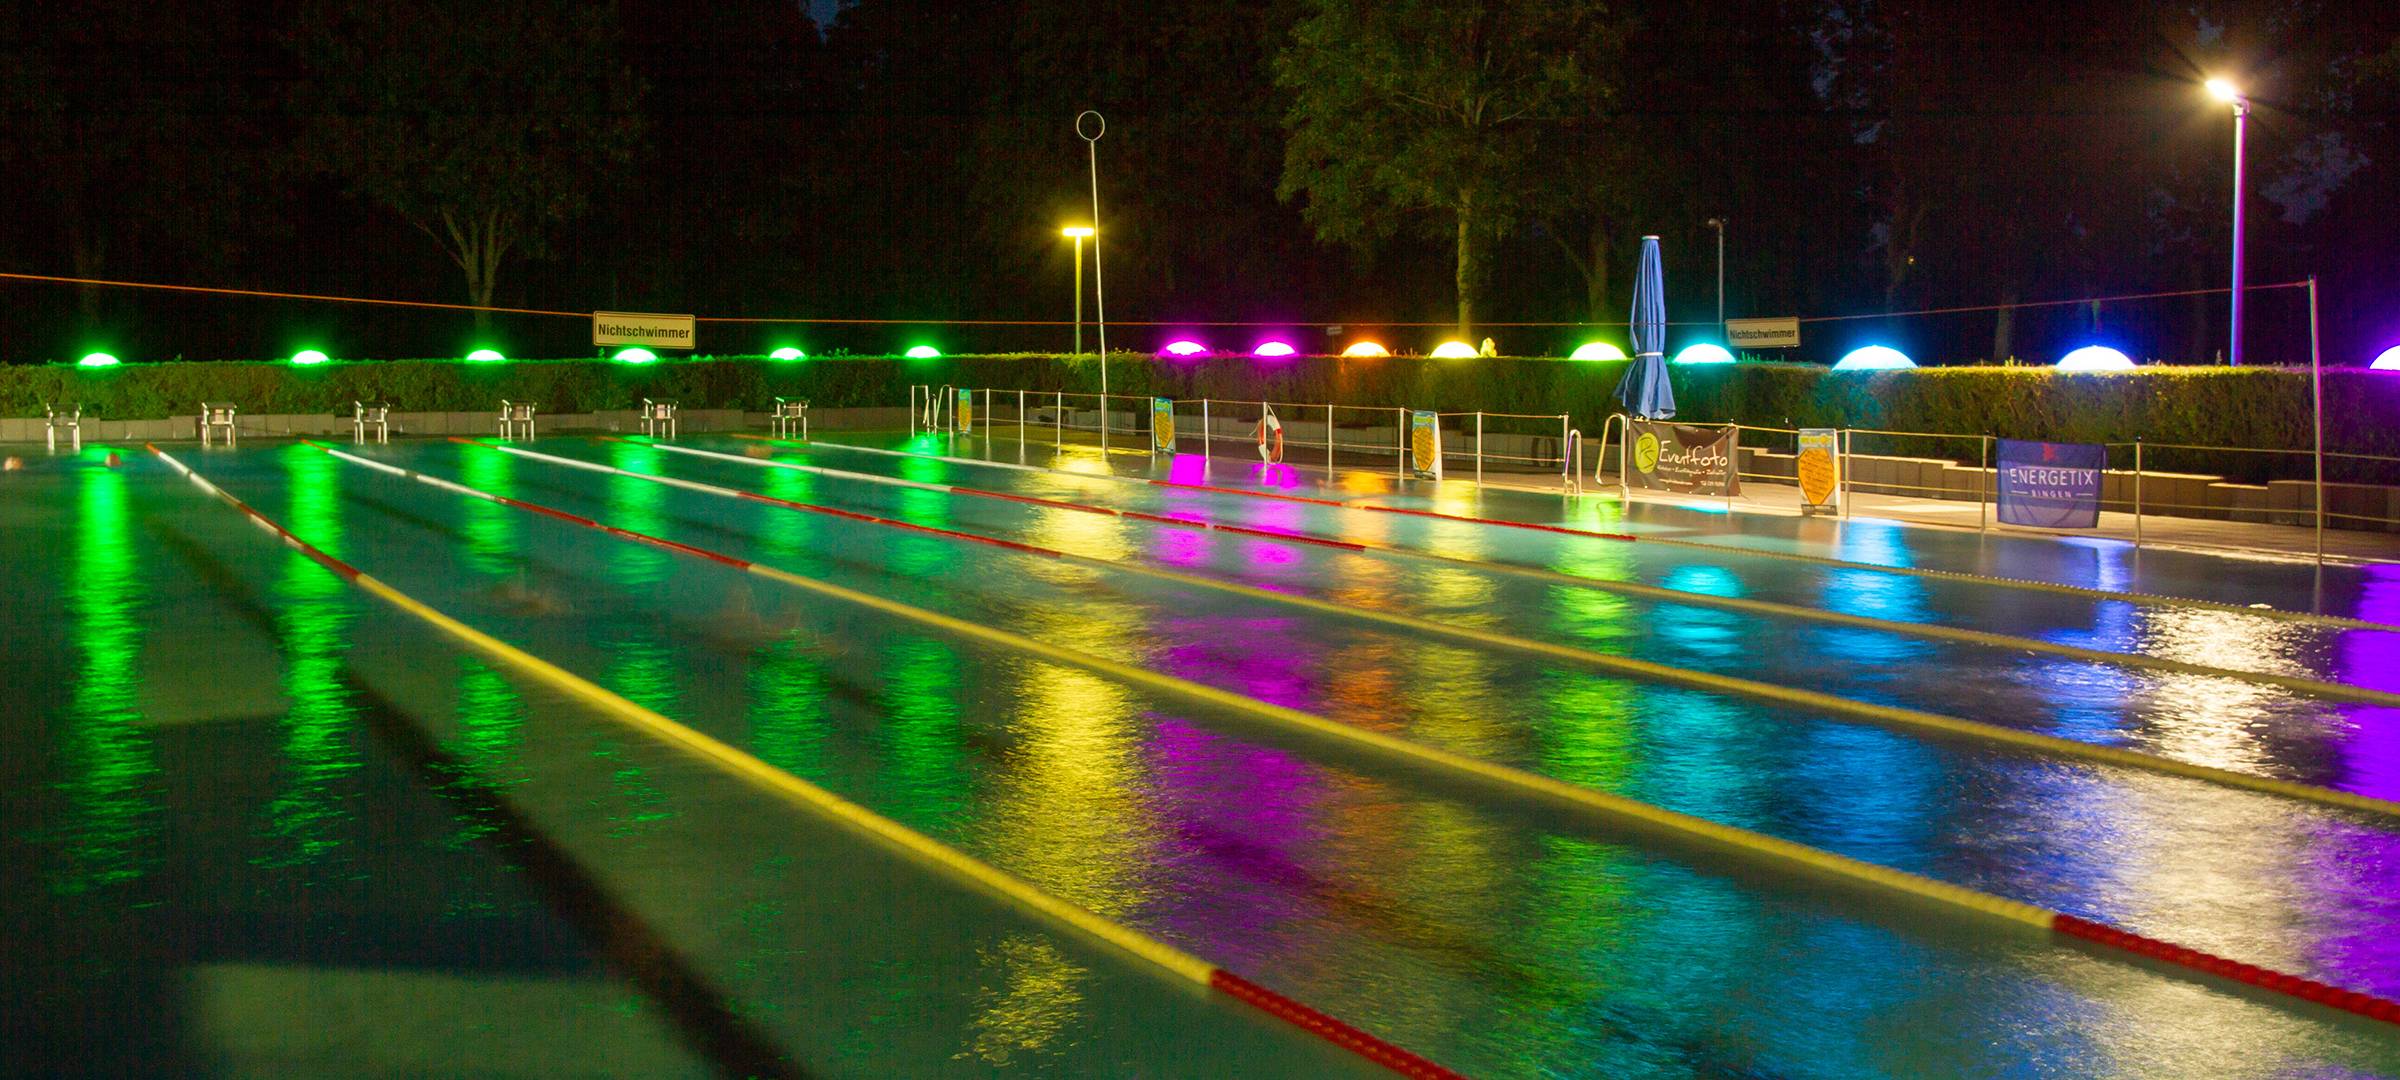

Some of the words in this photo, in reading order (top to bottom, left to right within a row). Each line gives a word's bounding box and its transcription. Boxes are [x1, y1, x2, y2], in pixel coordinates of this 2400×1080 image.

[598, 324, 690, 339] Nichtschwimmer
[1729, 328, 1795, 340] Nichtschwimmer
[1659, 440, 1728, 467] Eventfoto
[2009, 468, 2094, 485] ENERGETIX
